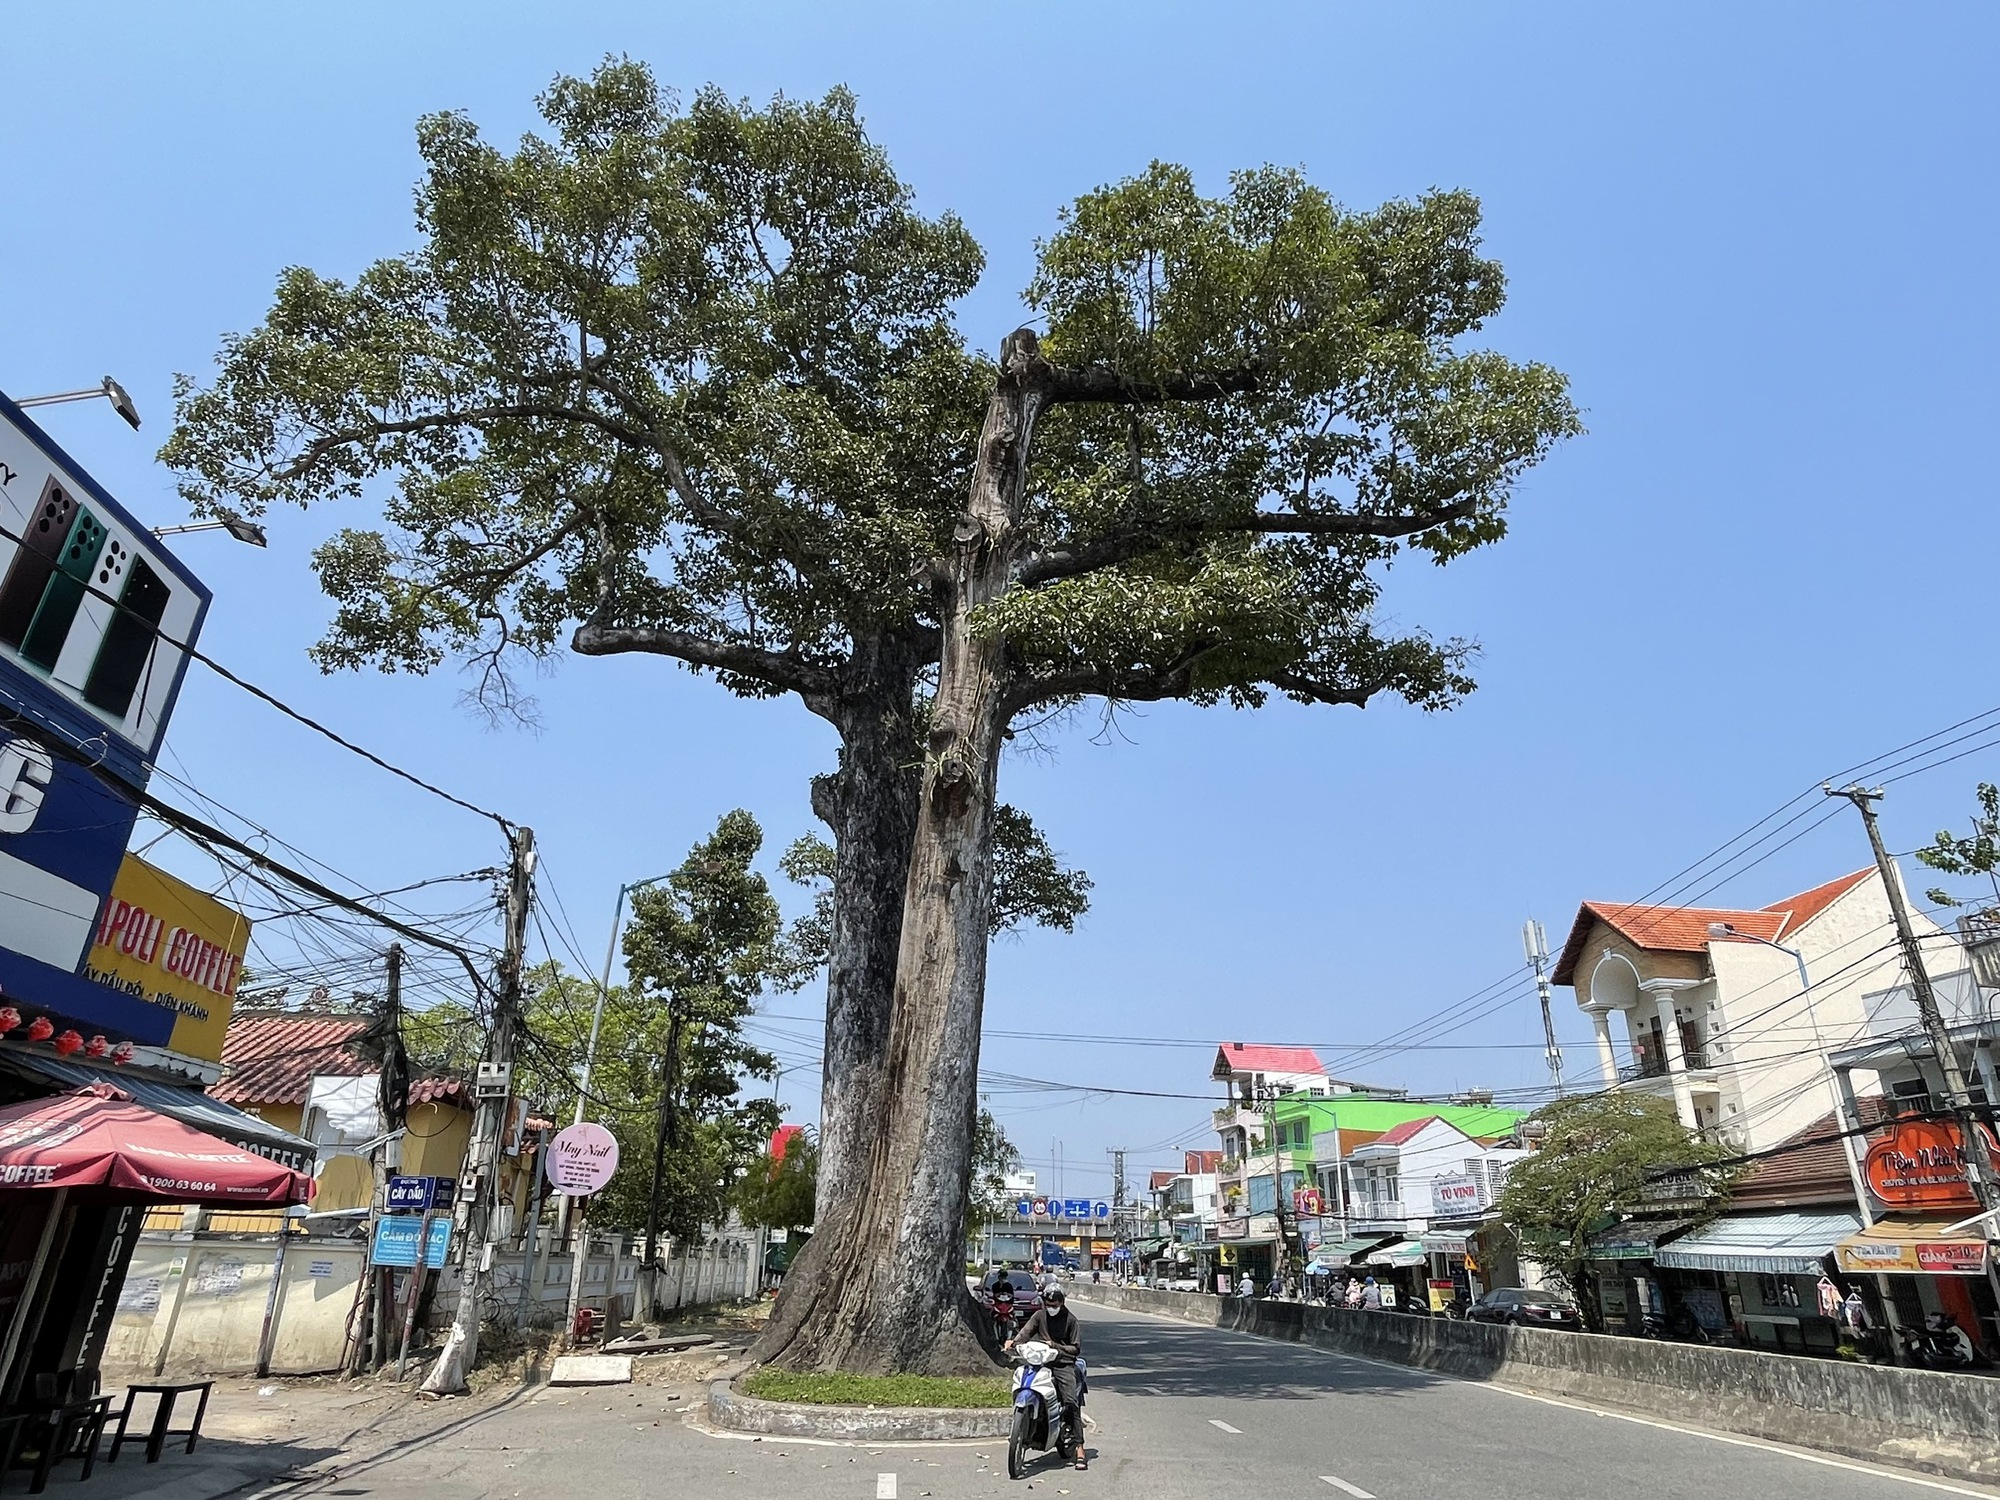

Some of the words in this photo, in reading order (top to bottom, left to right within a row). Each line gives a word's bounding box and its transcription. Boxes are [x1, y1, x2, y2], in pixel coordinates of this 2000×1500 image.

[162, 926, 241, 997] COFFEE
[555, 1141, 581, 1159] May
[583, 1144, 612, 1158] Nail
[149, 1177, 175, 1189] 1900
[176, 1179, 190, 1190] 63
[190, 1181, 204, 1191] 60
[204, 1182, 217, 1192] 64
[1453, 1185, 1475, 1199] VINH
[75, 1206, 132, 1370] COFFE
